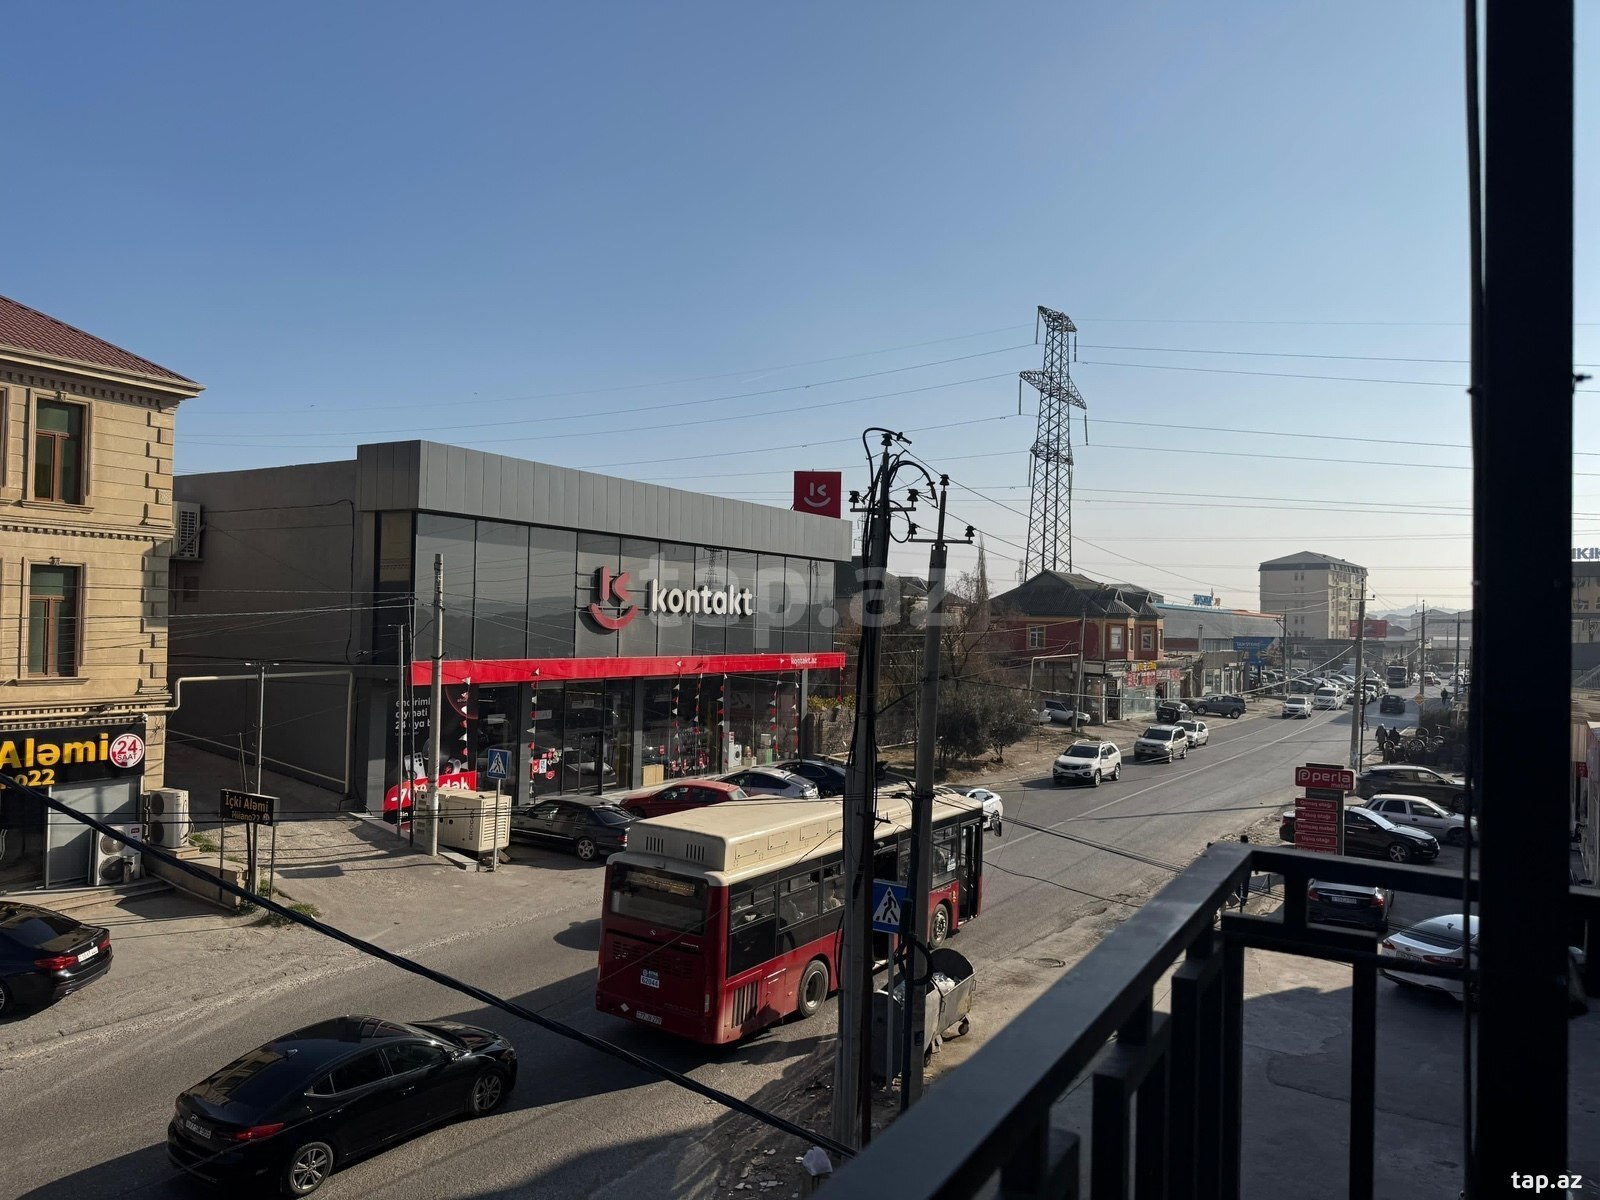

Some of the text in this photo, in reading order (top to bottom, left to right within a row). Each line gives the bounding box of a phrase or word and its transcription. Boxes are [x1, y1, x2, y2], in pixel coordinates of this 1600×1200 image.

[651, 579, 753, 616] kontakt
[0, 732, 109, 769] Aləmi
[117, 739, 138, 755] 24
[117, 753, 138, 761] SAAT
[1312, 771, 1351, 783] perla
[225, 791, 269, 813] İçki Aləmi
